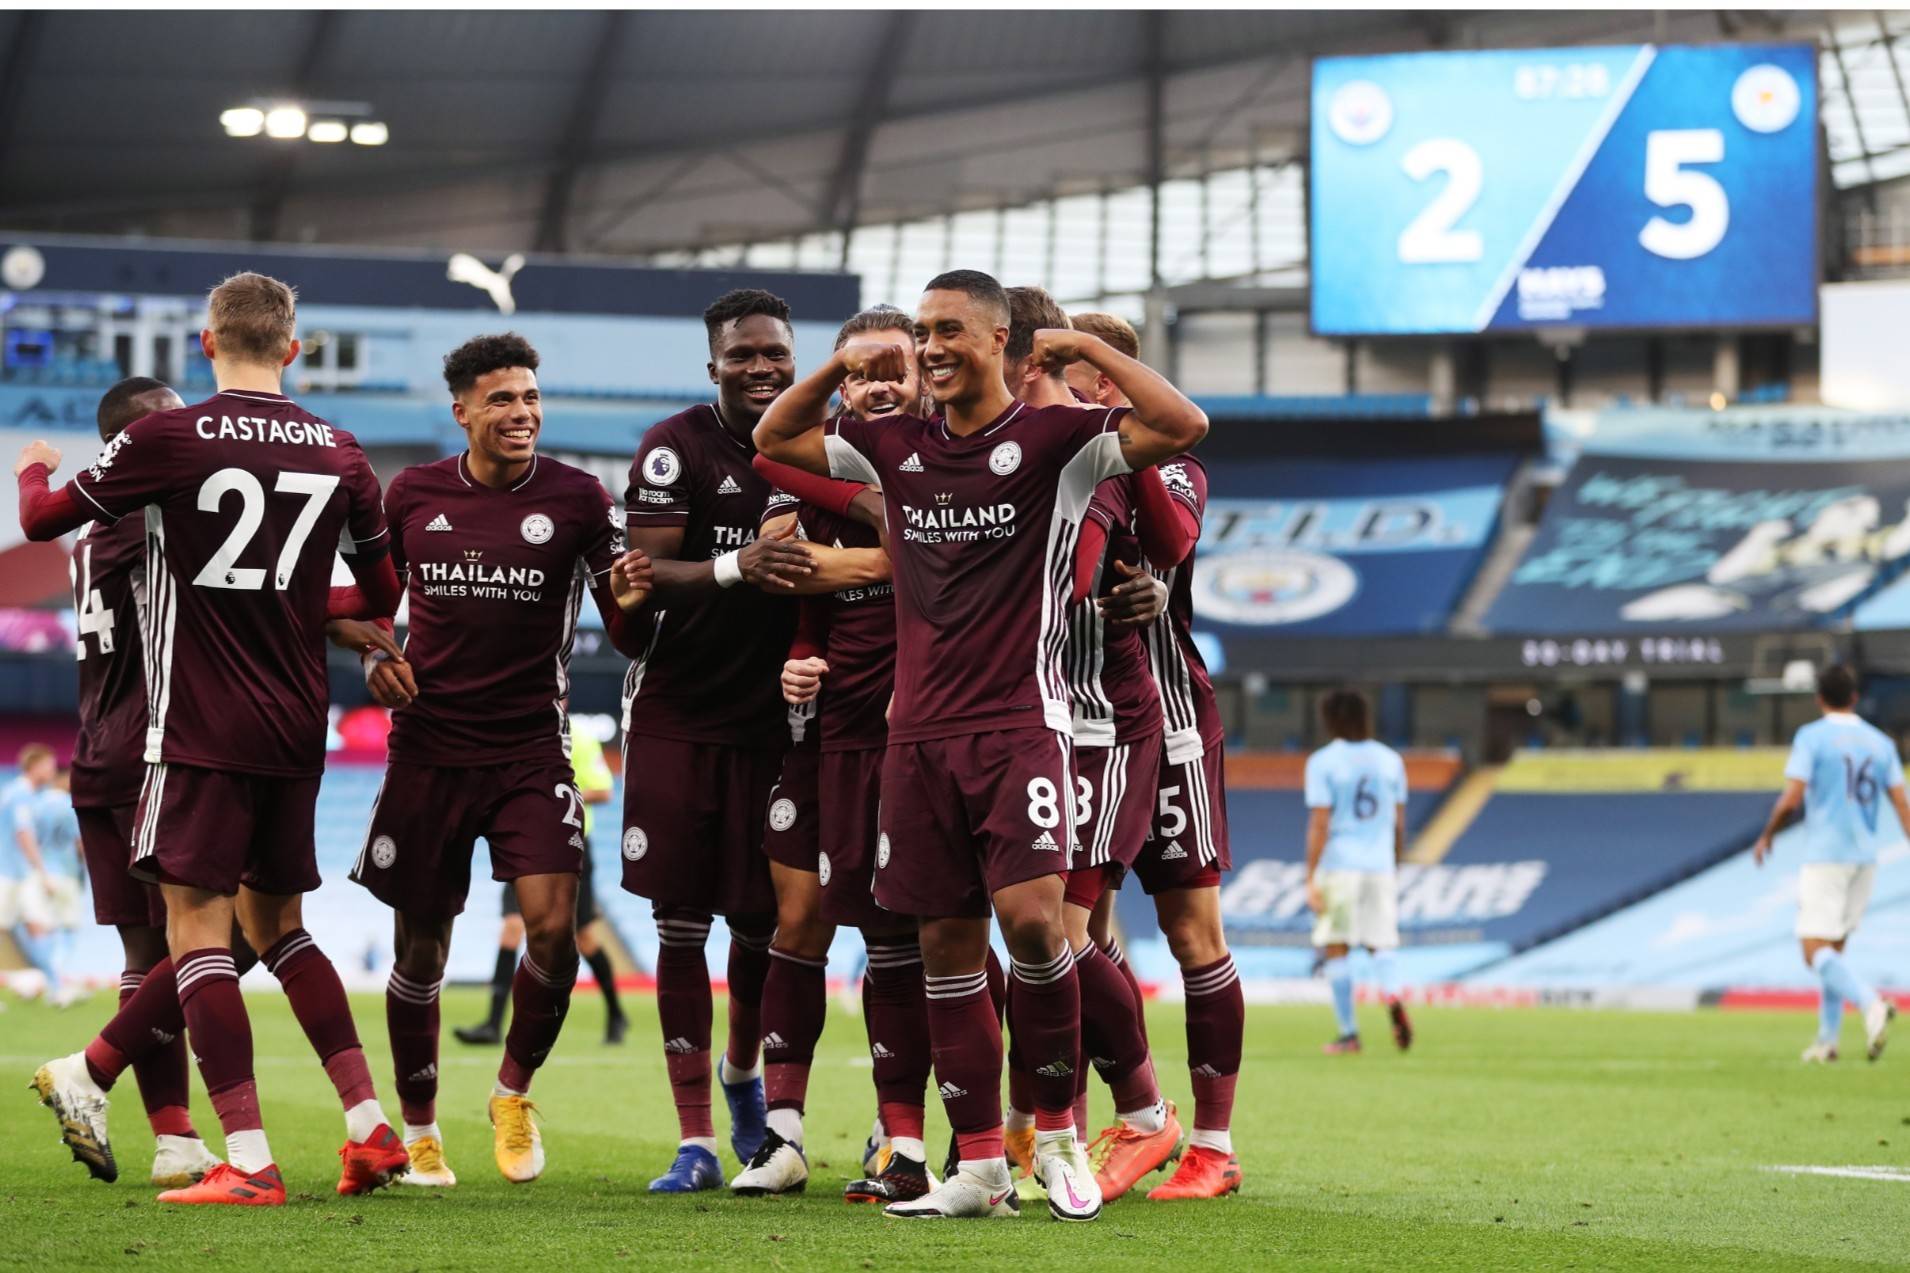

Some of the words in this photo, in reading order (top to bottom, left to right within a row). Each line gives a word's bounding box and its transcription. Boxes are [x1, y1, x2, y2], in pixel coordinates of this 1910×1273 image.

[1398, 138, 1484, 264] 2
[1639, 129, 1731, 260] 5
[195, 415, 337, 448] CASTAGNE
[192, 467, 341, 590] 27
[902, 503, 1016, 529] THAILAND
[903, 528, 942, 544] SMILES
[945, 531, 980, 542] WITH
[984, 524, 1016, 539] YOU
[420, 562, 545, 587] THAILAND
[424, 585, 467, 597] SMILES
[472, 586, 507, 599] WITH
[512, 589, 542, 602] YOU
[1353, 774, 1379, 821] 6
[1842, 753, 1878, 805] 16
[554, 783, 582, 829] 2
[1027, 777, 1060, 829] 8
[1148, 785, 1187, 838] 5
